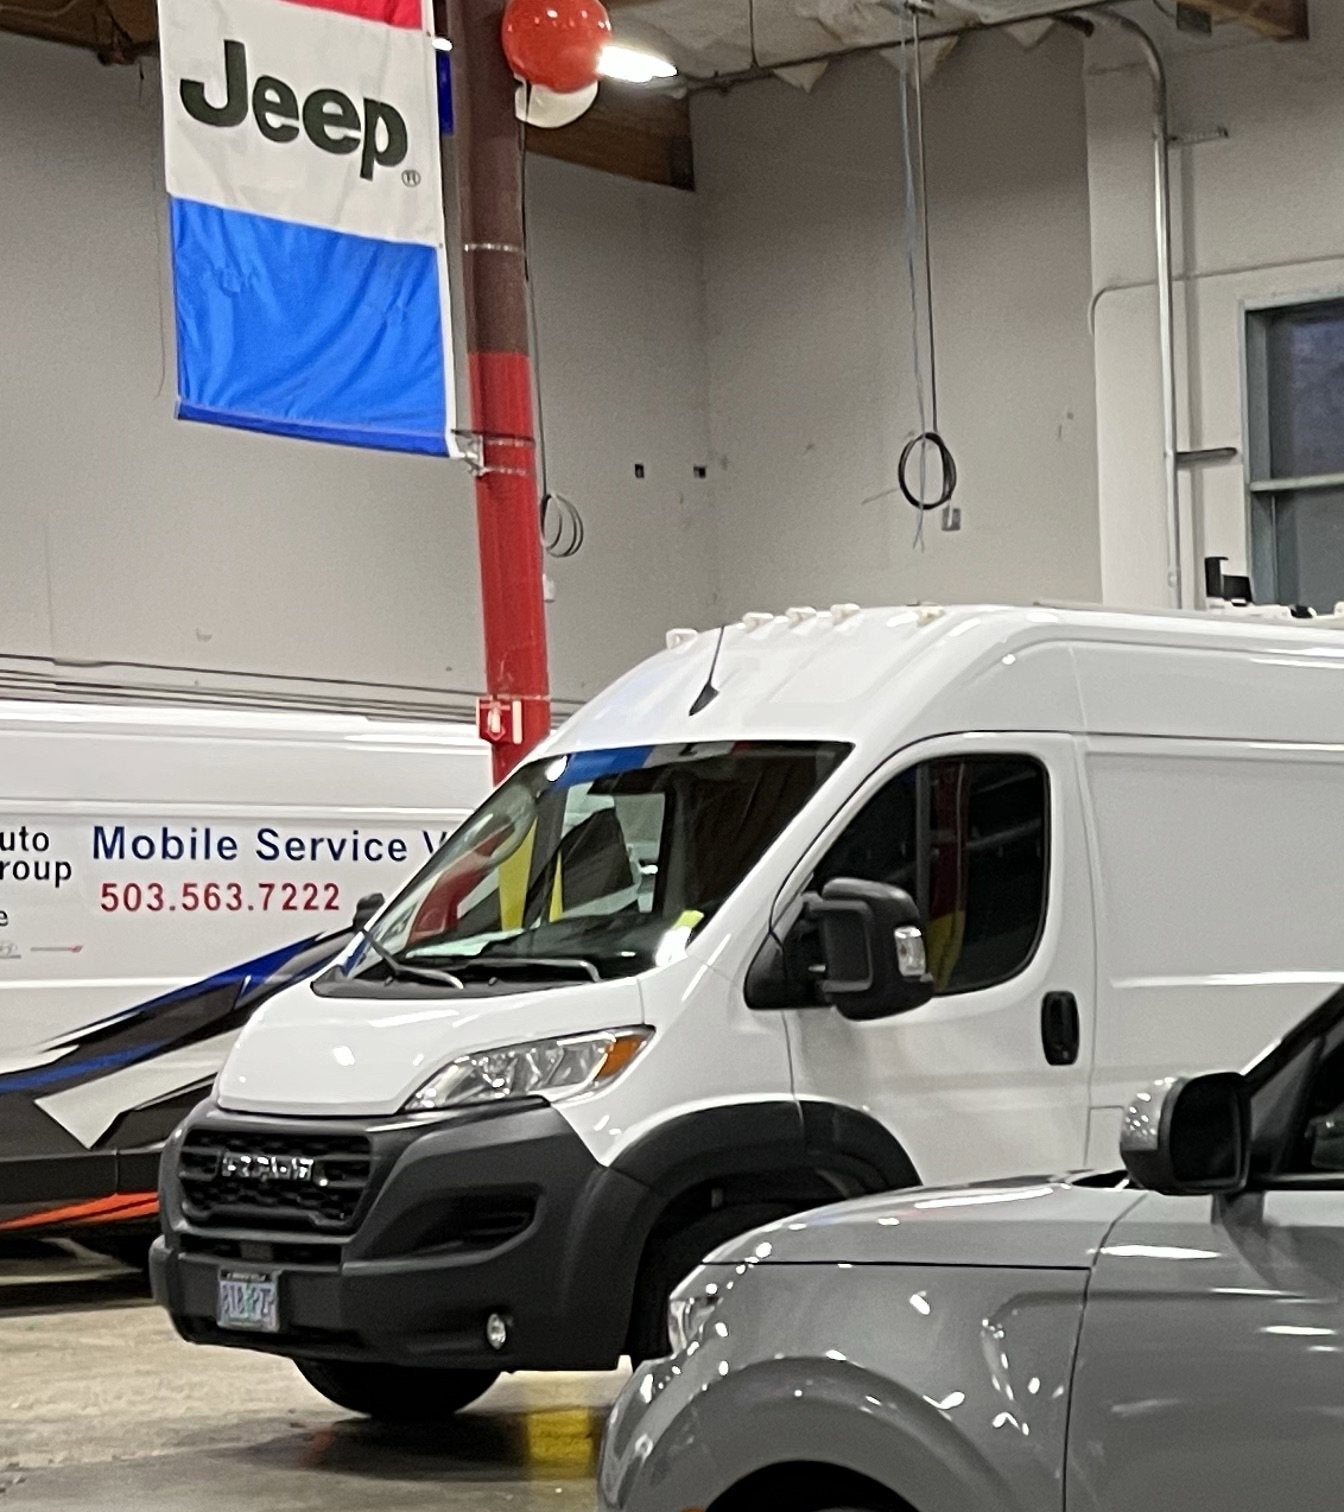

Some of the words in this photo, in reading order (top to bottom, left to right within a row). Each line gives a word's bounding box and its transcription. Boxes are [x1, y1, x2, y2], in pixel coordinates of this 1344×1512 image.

[180, 39, 408, 181] Jeep
[93, 826, 238, 860] Mobile
[255, 828, 408, 862] Service
[100, 882, 340, 912] 503.563.7222
